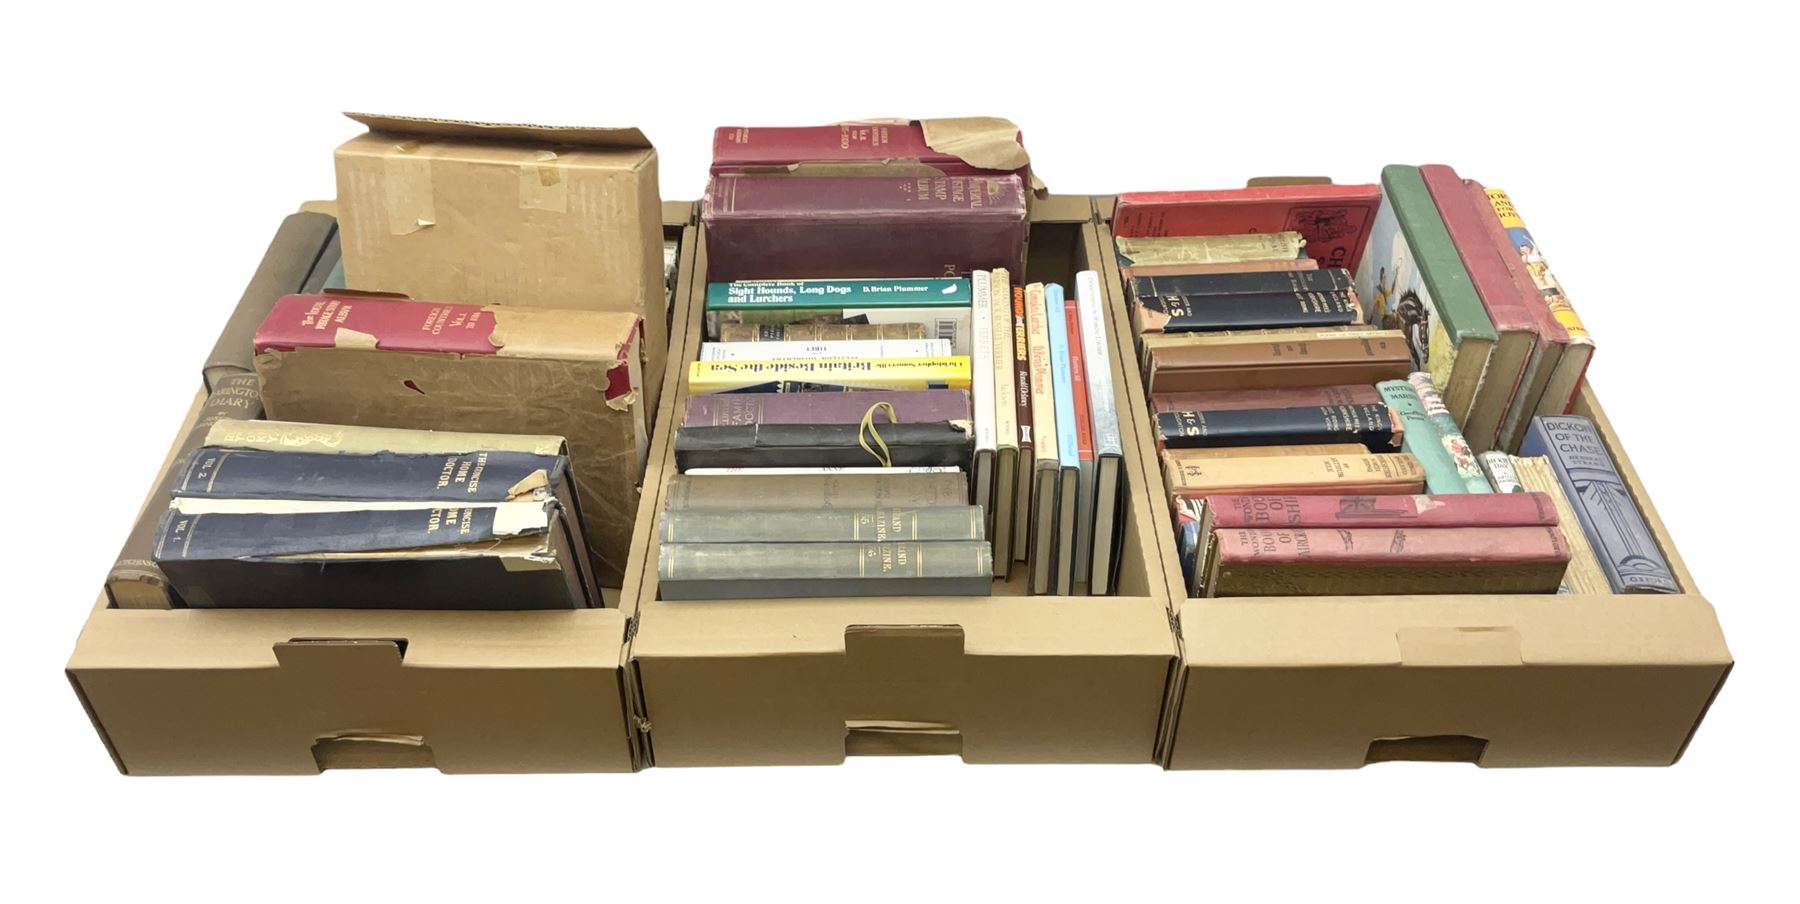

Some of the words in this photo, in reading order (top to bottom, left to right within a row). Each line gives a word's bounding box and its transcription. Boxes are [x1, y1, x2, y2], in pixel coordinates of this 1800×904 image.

[728, 287, 755, 296] Sight
[757, 286, 797, 296] Hounds,
[800, 286, 826, 296] Long
[827, 286, 851, 295] Dogs
[728, 295, 746, 303] and
[750, 294, 793, 303] Lurchers
[711, 365, 738, 374] Sea
[740, 364, 761, 373] the
[769, 363, 815, 373] Beside
[819, 361, 872, 371] Britain
[230, 377, 255, 386] THE
[1363, 406, 1375, 431] NGLAND
[1555, 433, 1570, 441] OF
[436, 456, 457, 489] DOCTOR.
[455, 461, 472, 483] HOME
[467, 466, 484, 493] CONCISE
[427, 508, 442, 534] CTOR.
[446, 508, 460, 525] OME
[1249, 529, 1260, 556] WOND
